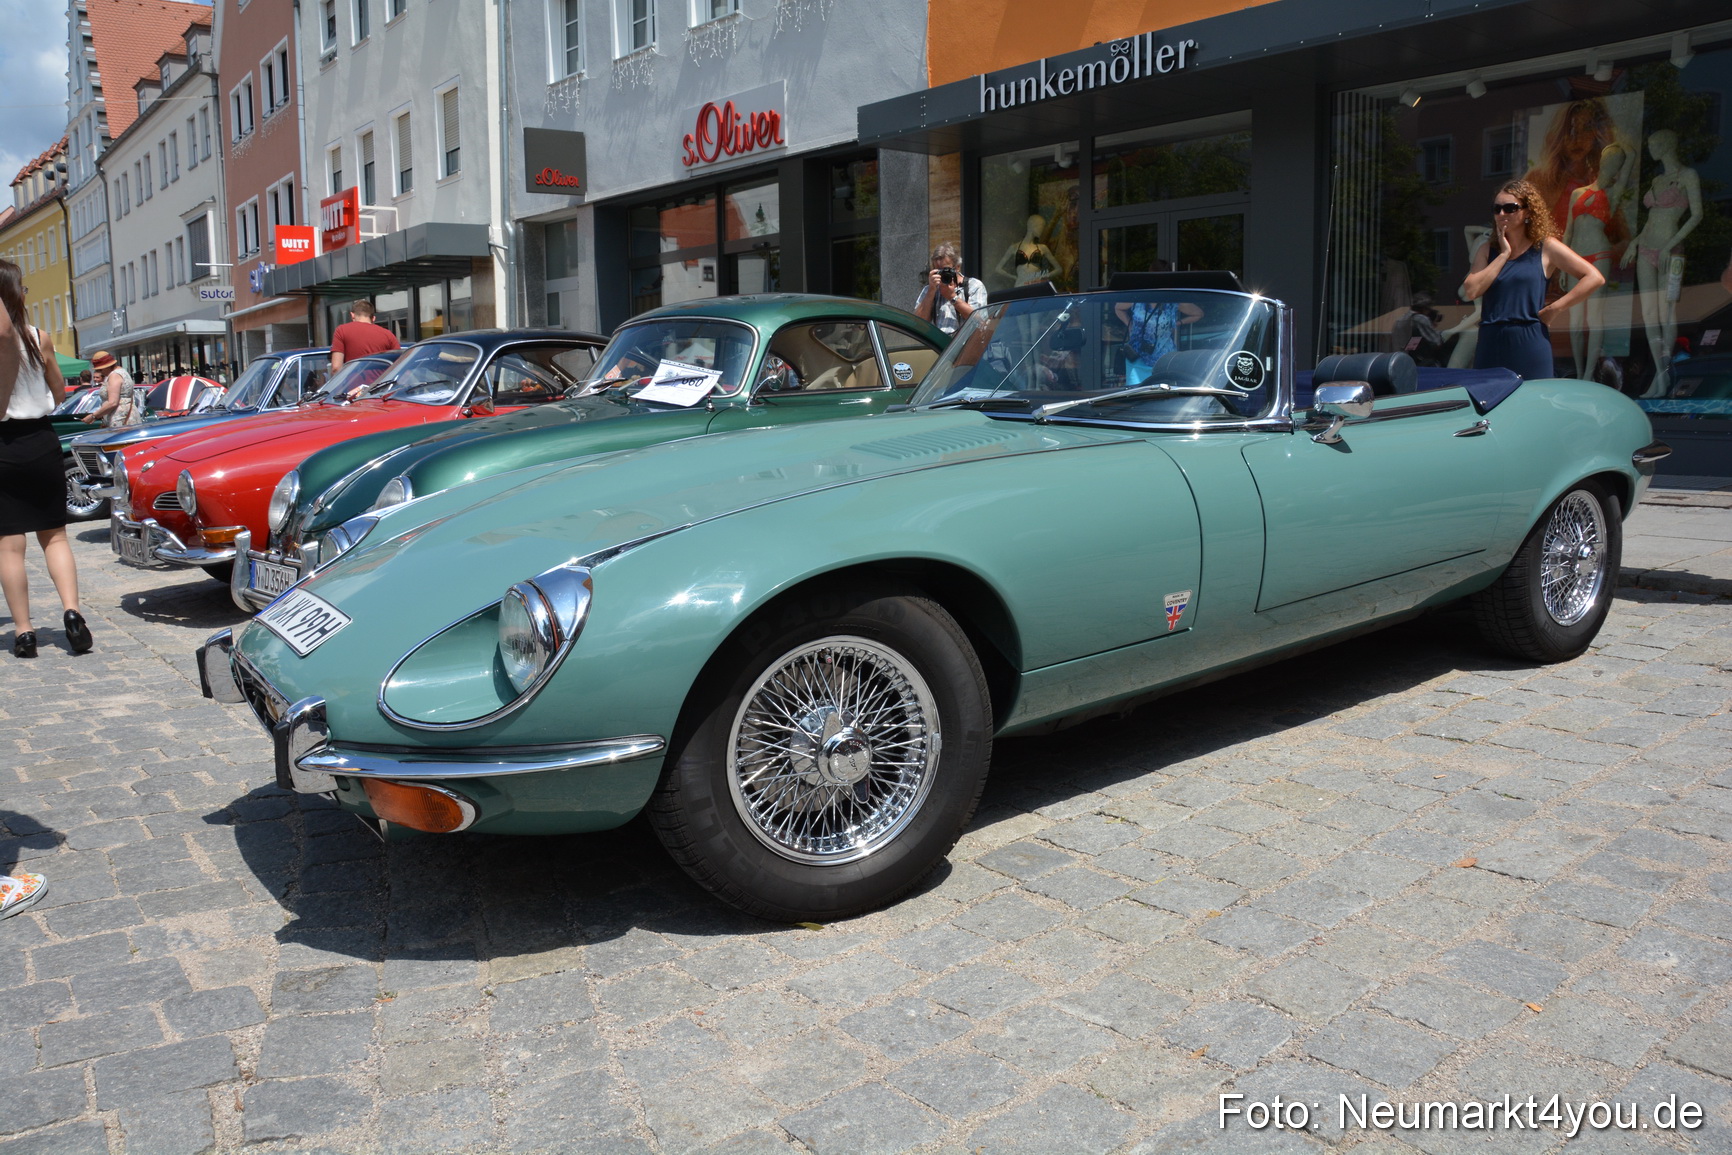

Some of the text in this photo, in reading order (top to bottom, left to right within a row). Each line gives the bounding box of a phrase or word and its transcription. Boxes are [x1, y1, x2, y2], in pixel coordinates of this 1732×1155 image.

[980, 32, 1195, 113] hunkemöller
[682, 100, 784, 167] s.Oliver
[534, 166, 580, 188] s.Oliver
[320, 200, 345, 233] WITT
[281, 238, 310, 249] WITT
[1234, 375, 1259, 384] JAGUAR
[272, 597, 316, 628] XK
[1167, 597, 1187, 606] COVENTRY
[286, 607, 343, 648] 99H
